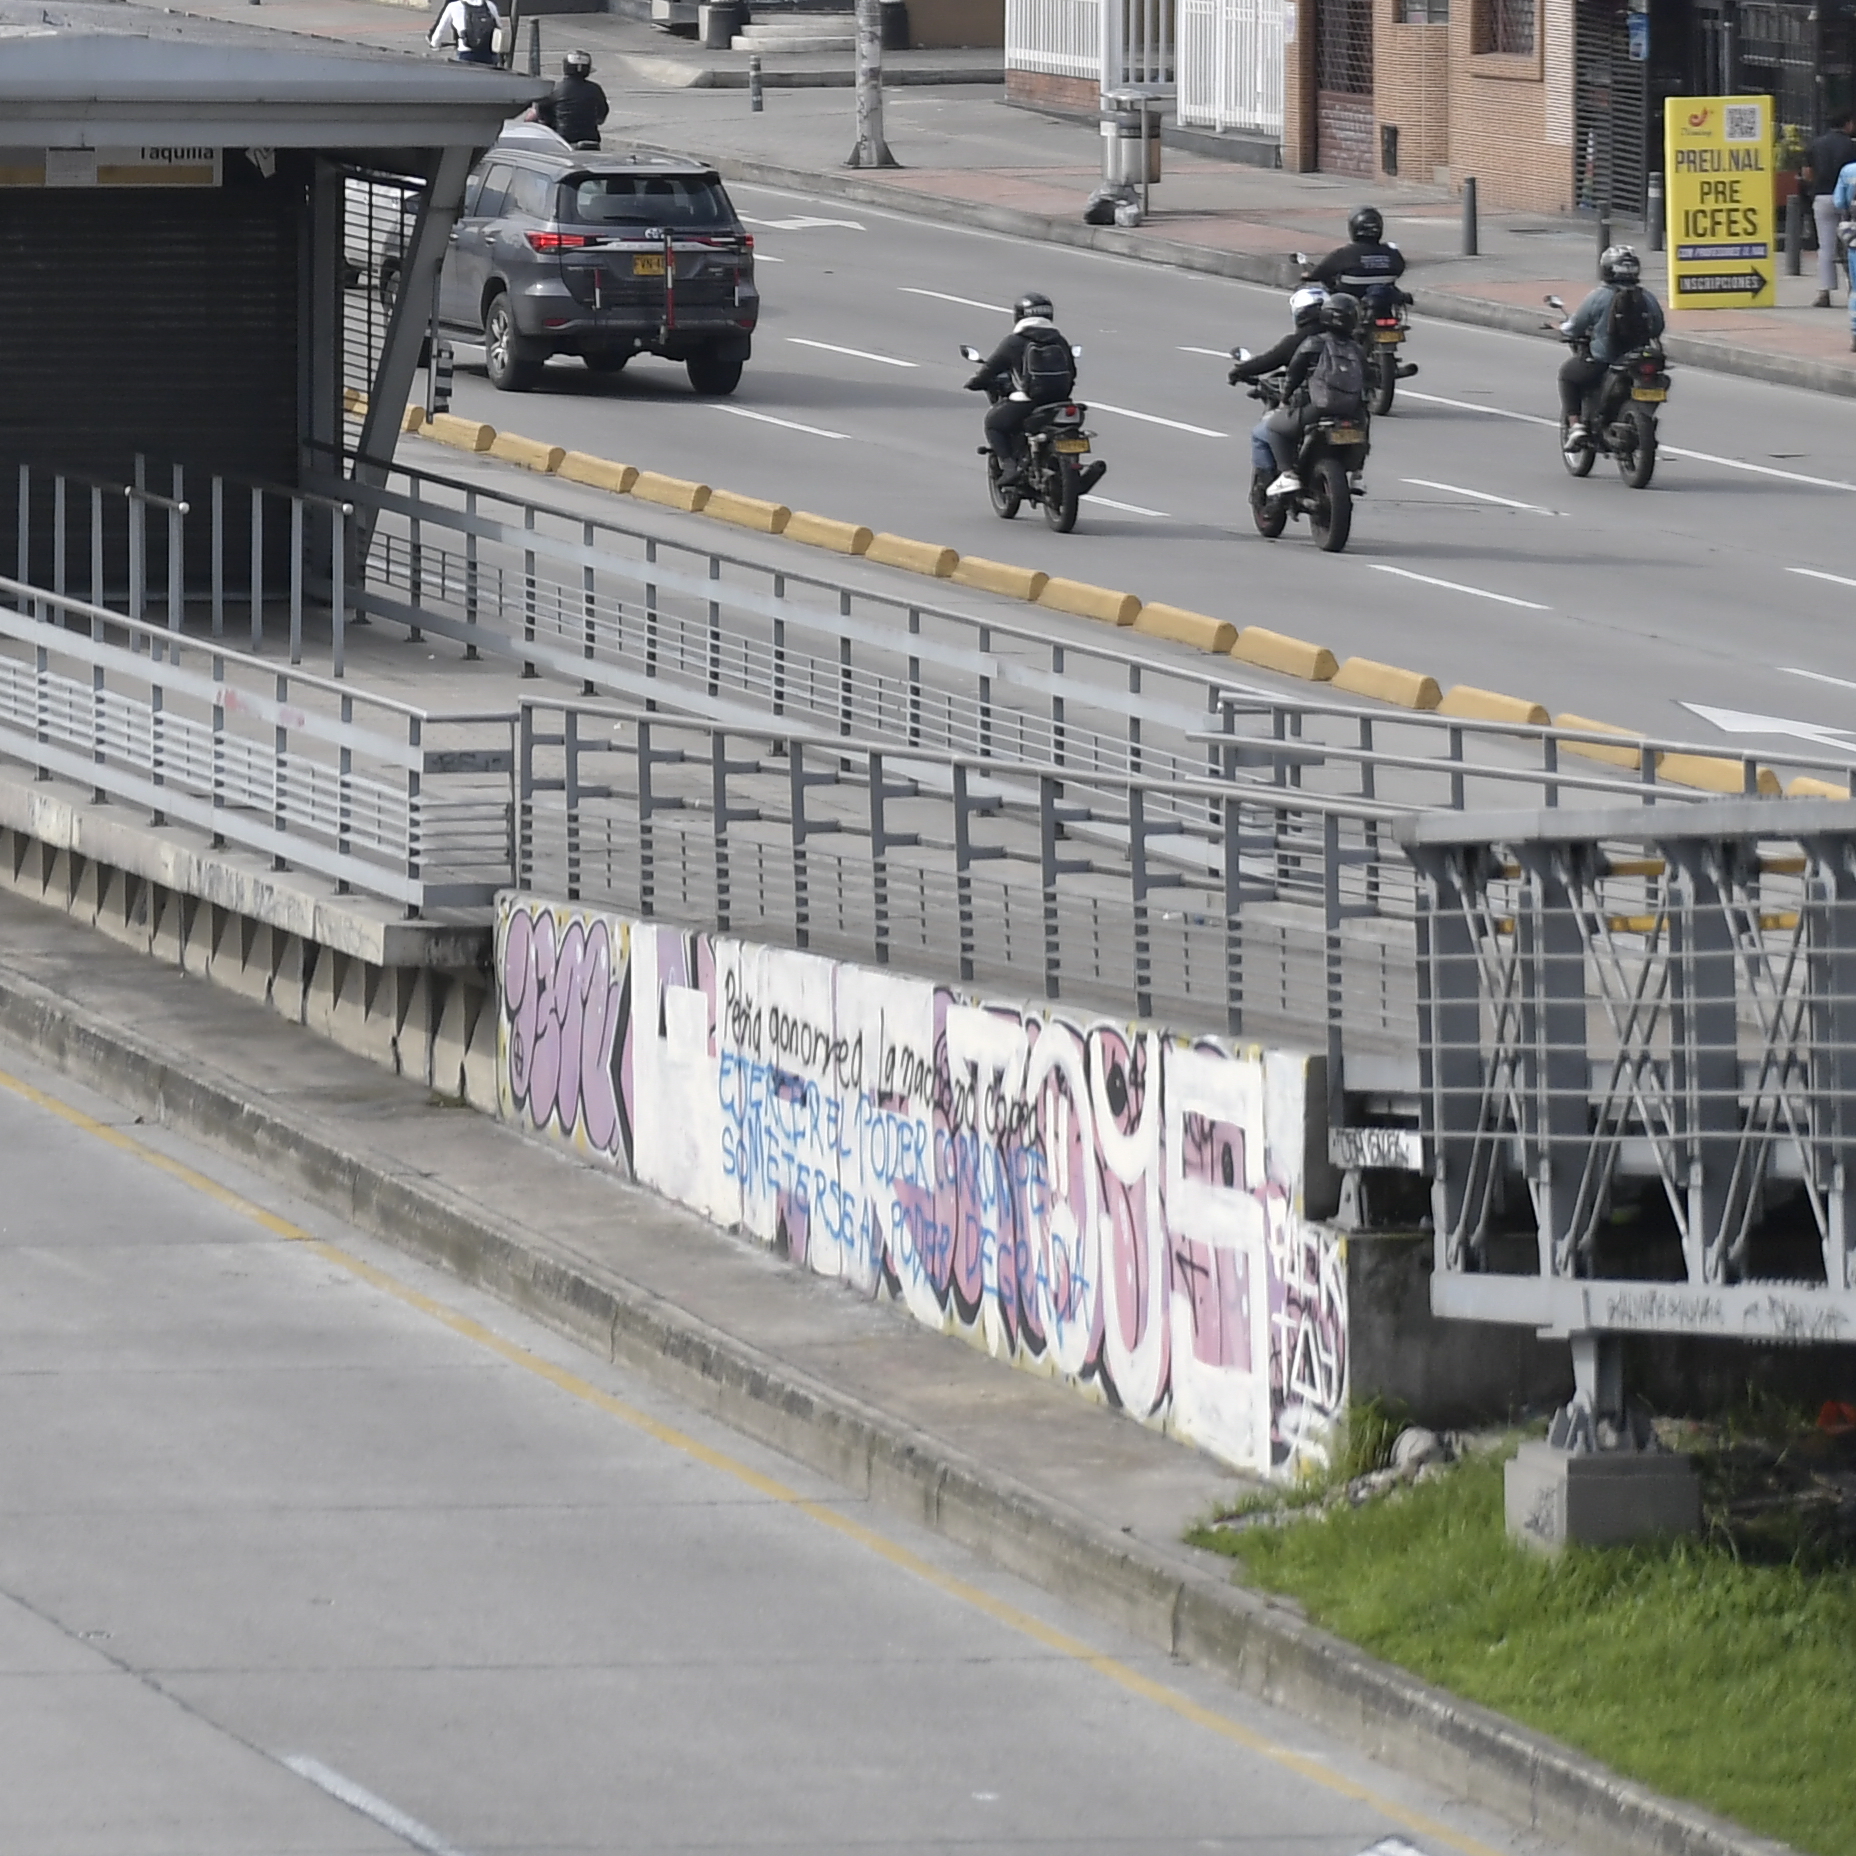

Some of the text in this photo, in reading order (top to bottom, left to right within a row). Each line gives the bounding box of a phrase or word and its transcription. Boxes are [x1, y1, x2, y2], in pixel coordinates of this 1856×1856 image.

[1674, 148, 1765, 174] PREU.NAL
[1699, 179, 1742, 204] PRE
[1683, 207, 1759, 238] ICFES
[1679, 275, 1760, 291] INSCRIPCIONES
[724, 970, 764, 1059] Peña
[719, 1048, 823, 1155] EJERCER
[855, 1092, 936, 1195] PODER
[720, 1127, 857, 1248] SOMETERSE
